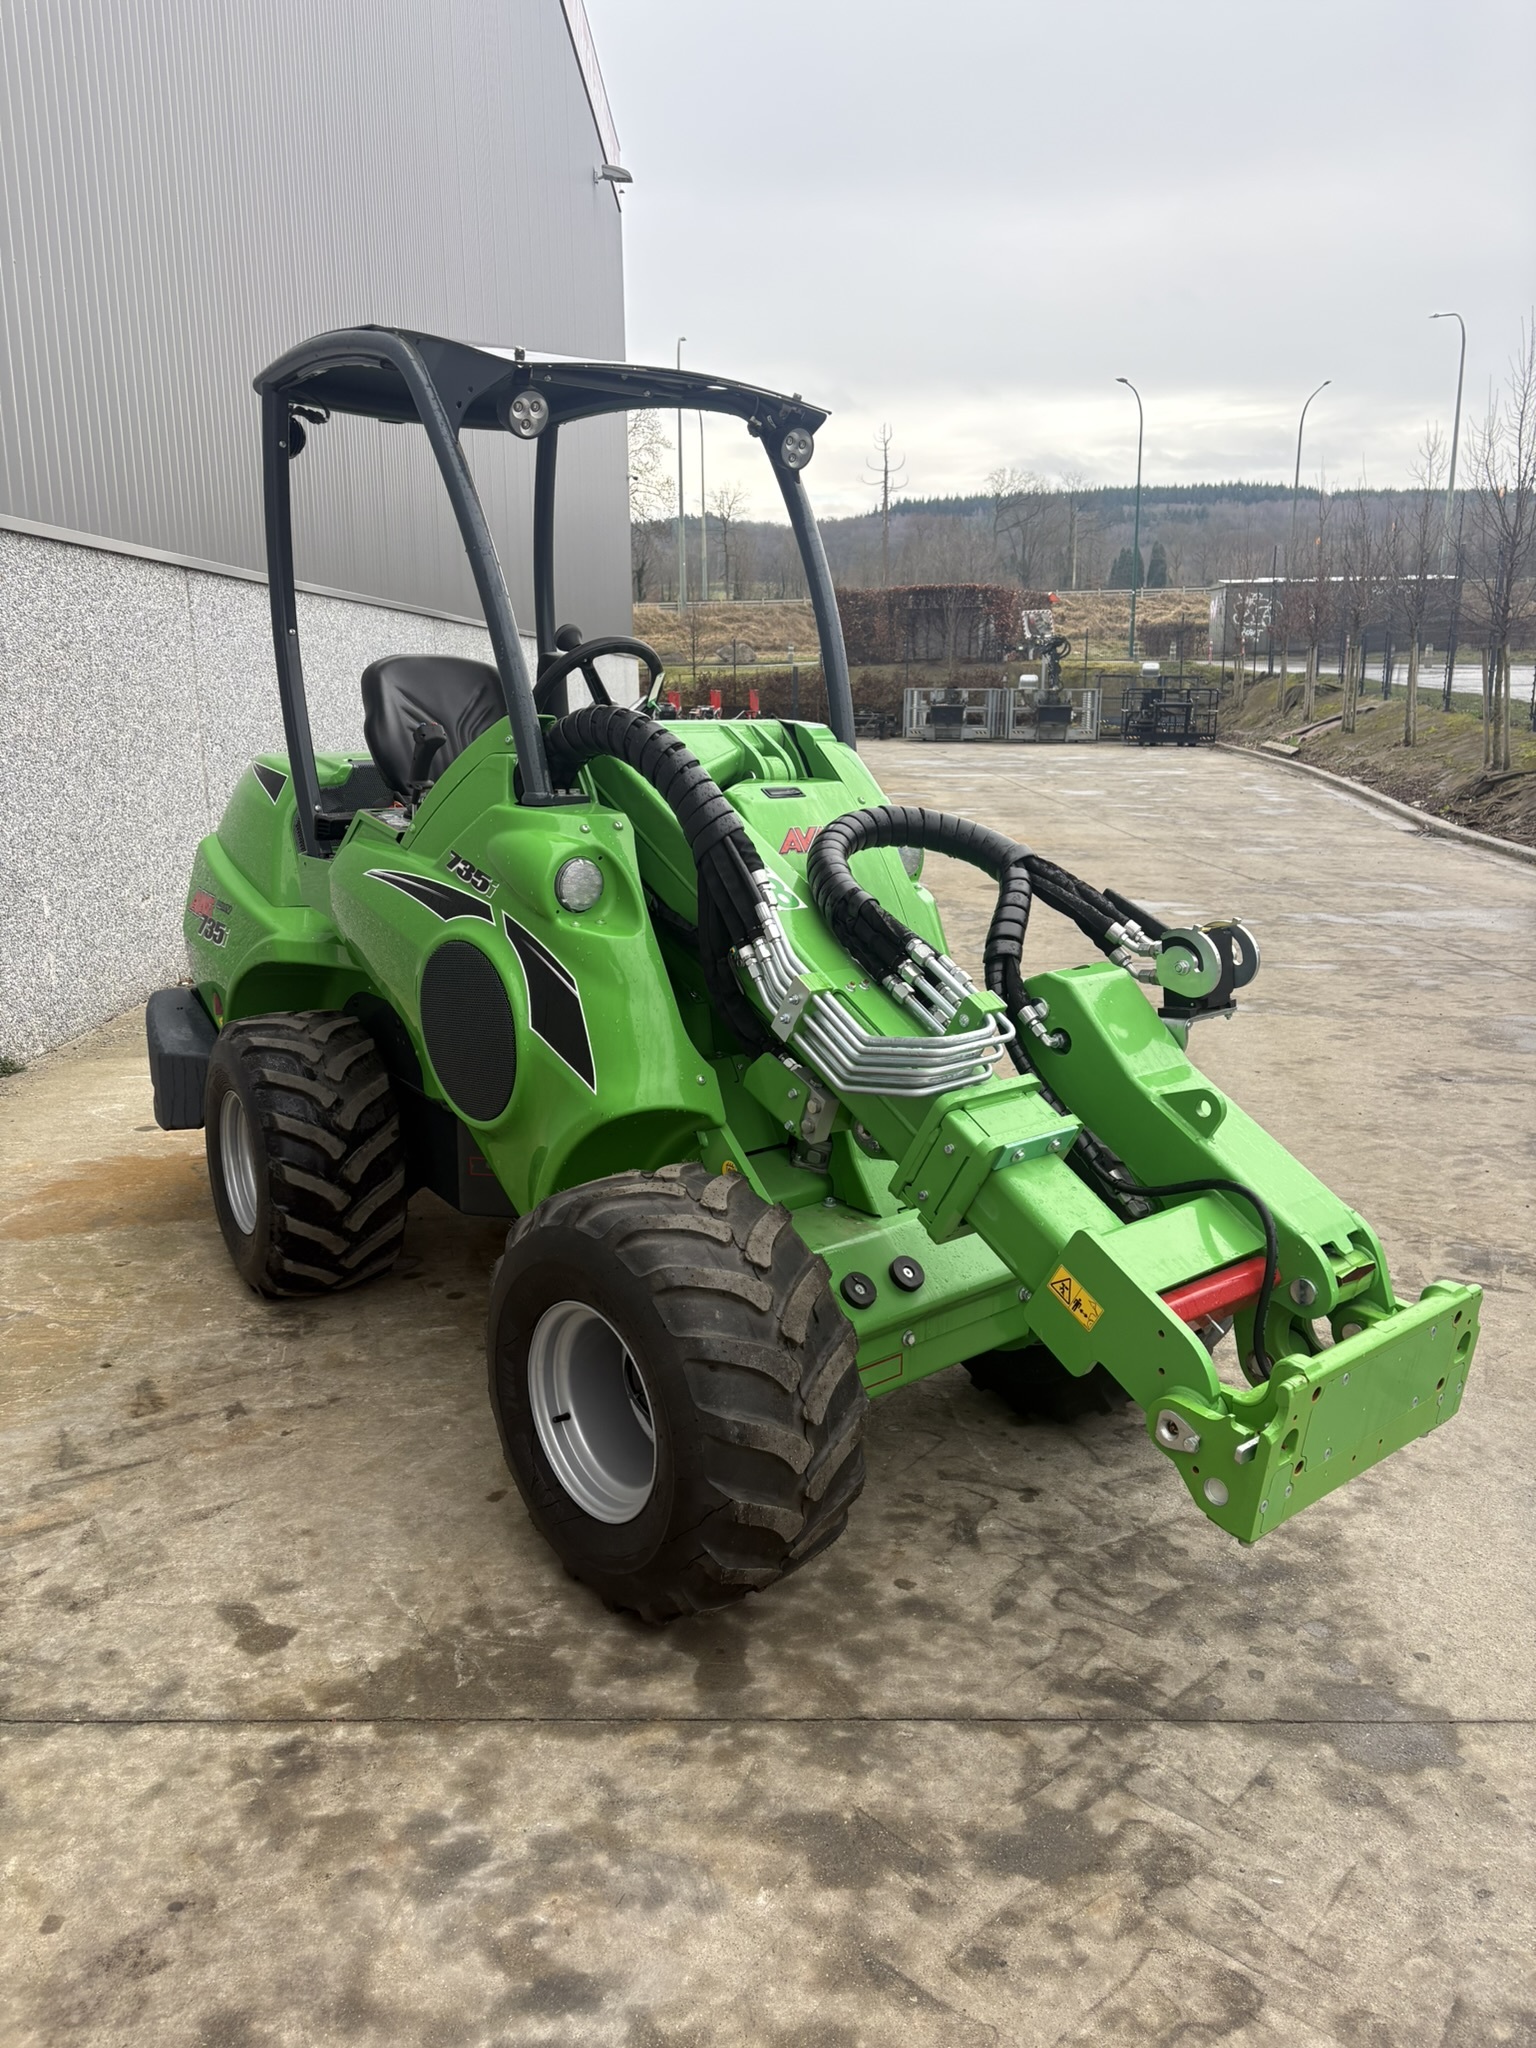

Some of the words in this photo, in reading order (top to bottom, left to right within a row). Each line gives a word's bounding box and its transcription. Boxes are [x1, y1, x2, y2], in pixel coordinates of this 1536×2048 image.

[780, 827, 823, 854] AV
[445, 849, 500, 898] 735i
[197, 914, 231, 948] 735i
